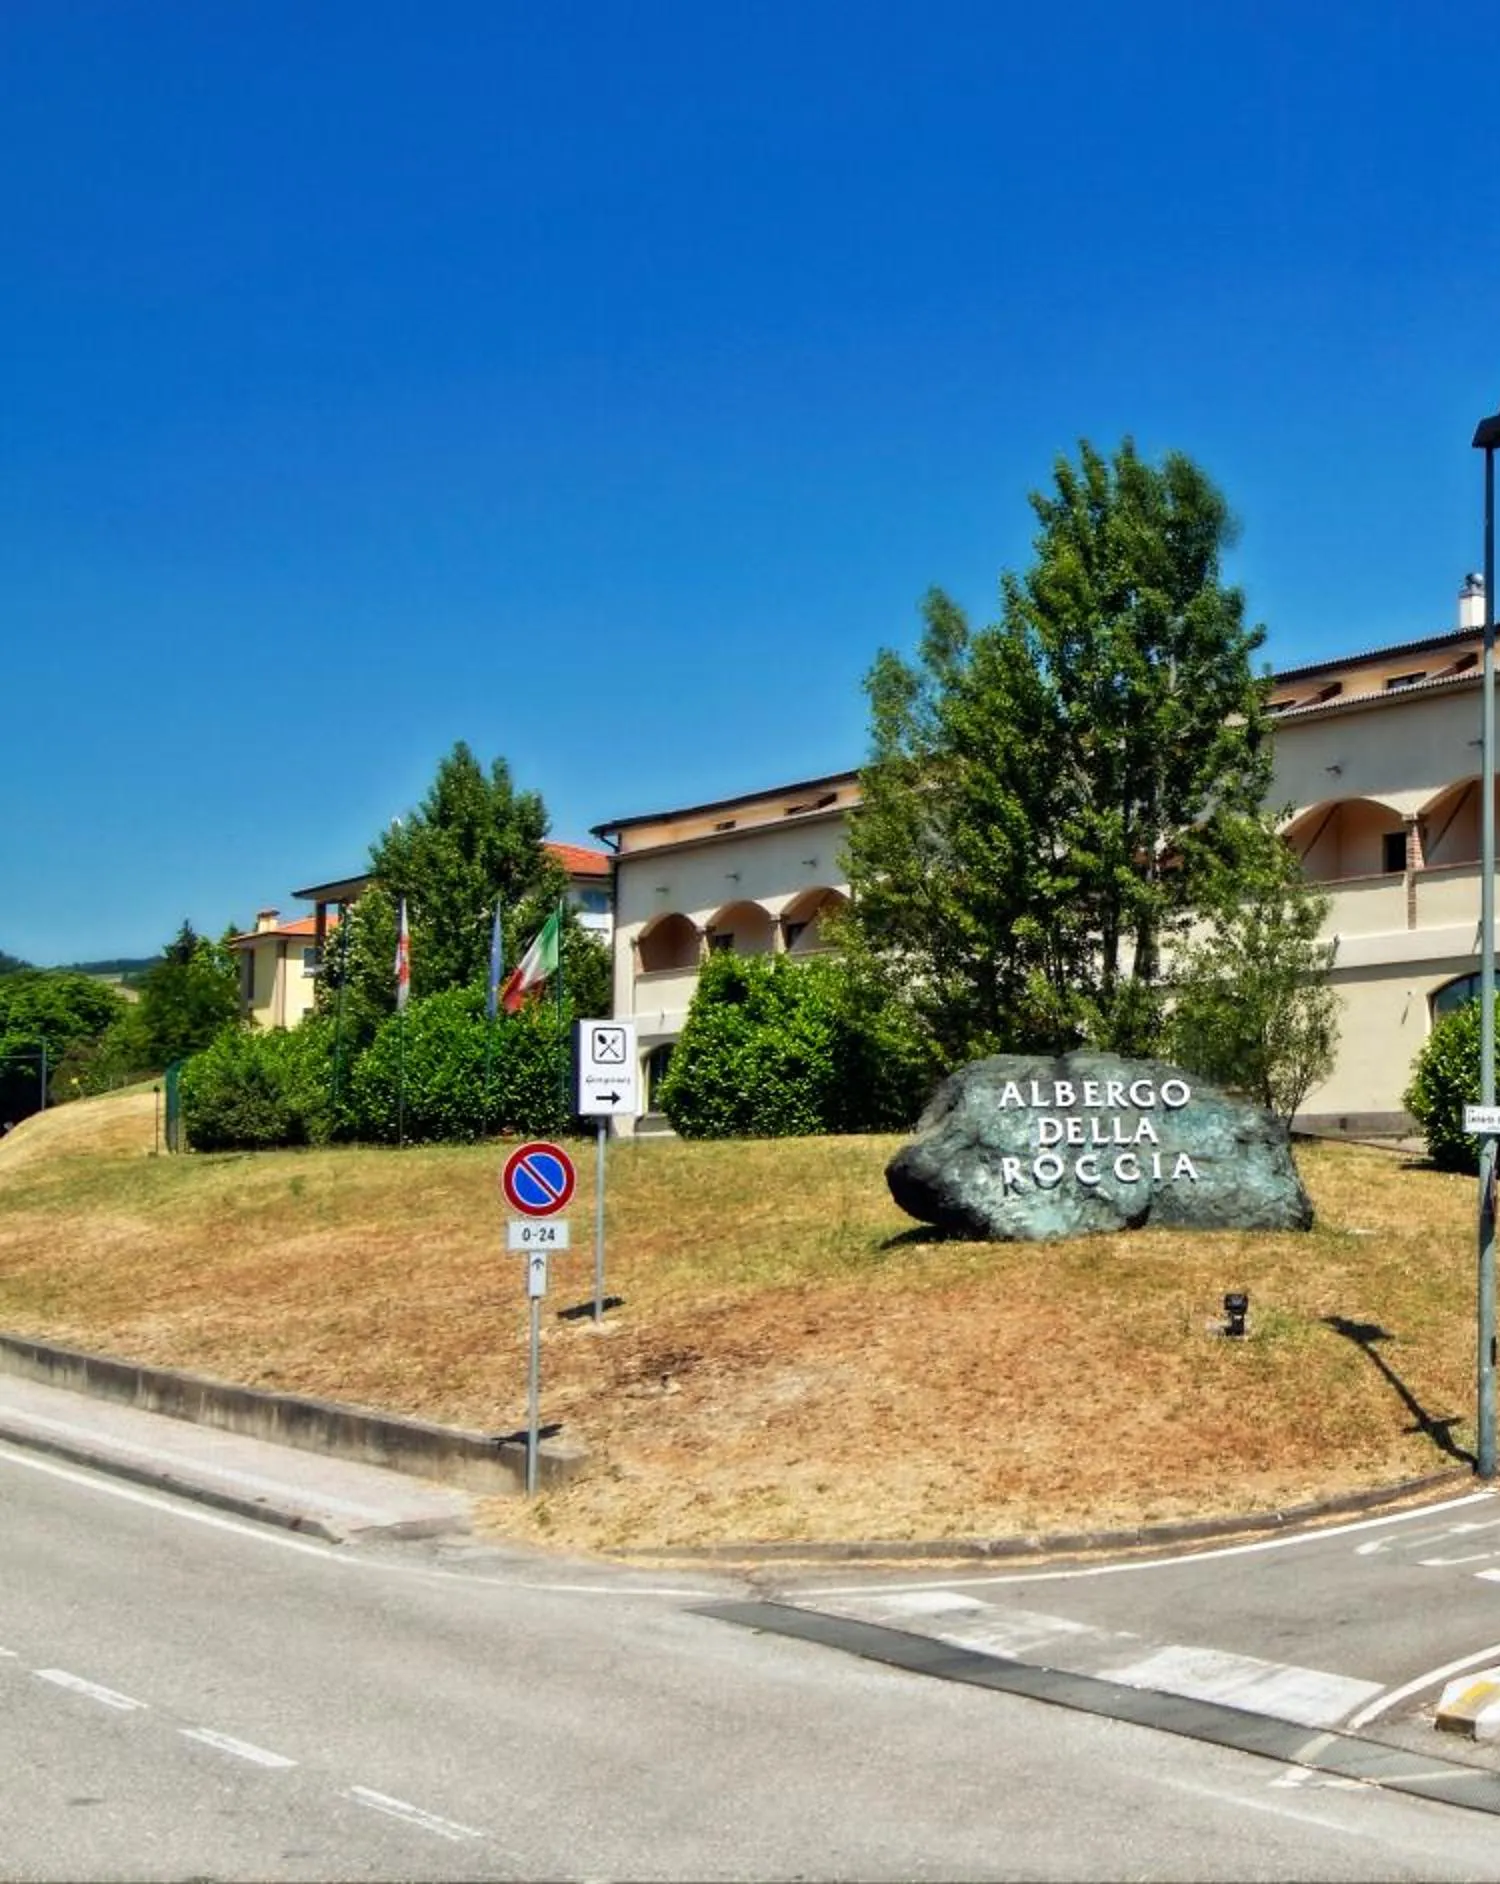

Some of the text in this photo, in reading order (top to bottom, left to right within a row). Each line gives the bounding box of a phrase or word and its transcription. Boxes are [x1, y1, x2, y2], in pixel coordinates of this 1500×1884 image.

[998, 1078, 1191, 1109] ALBERGO
[1038, 1116, 1159, 1145] DELLA
[1002, 1152, 1200, 1184] ROCCIA
